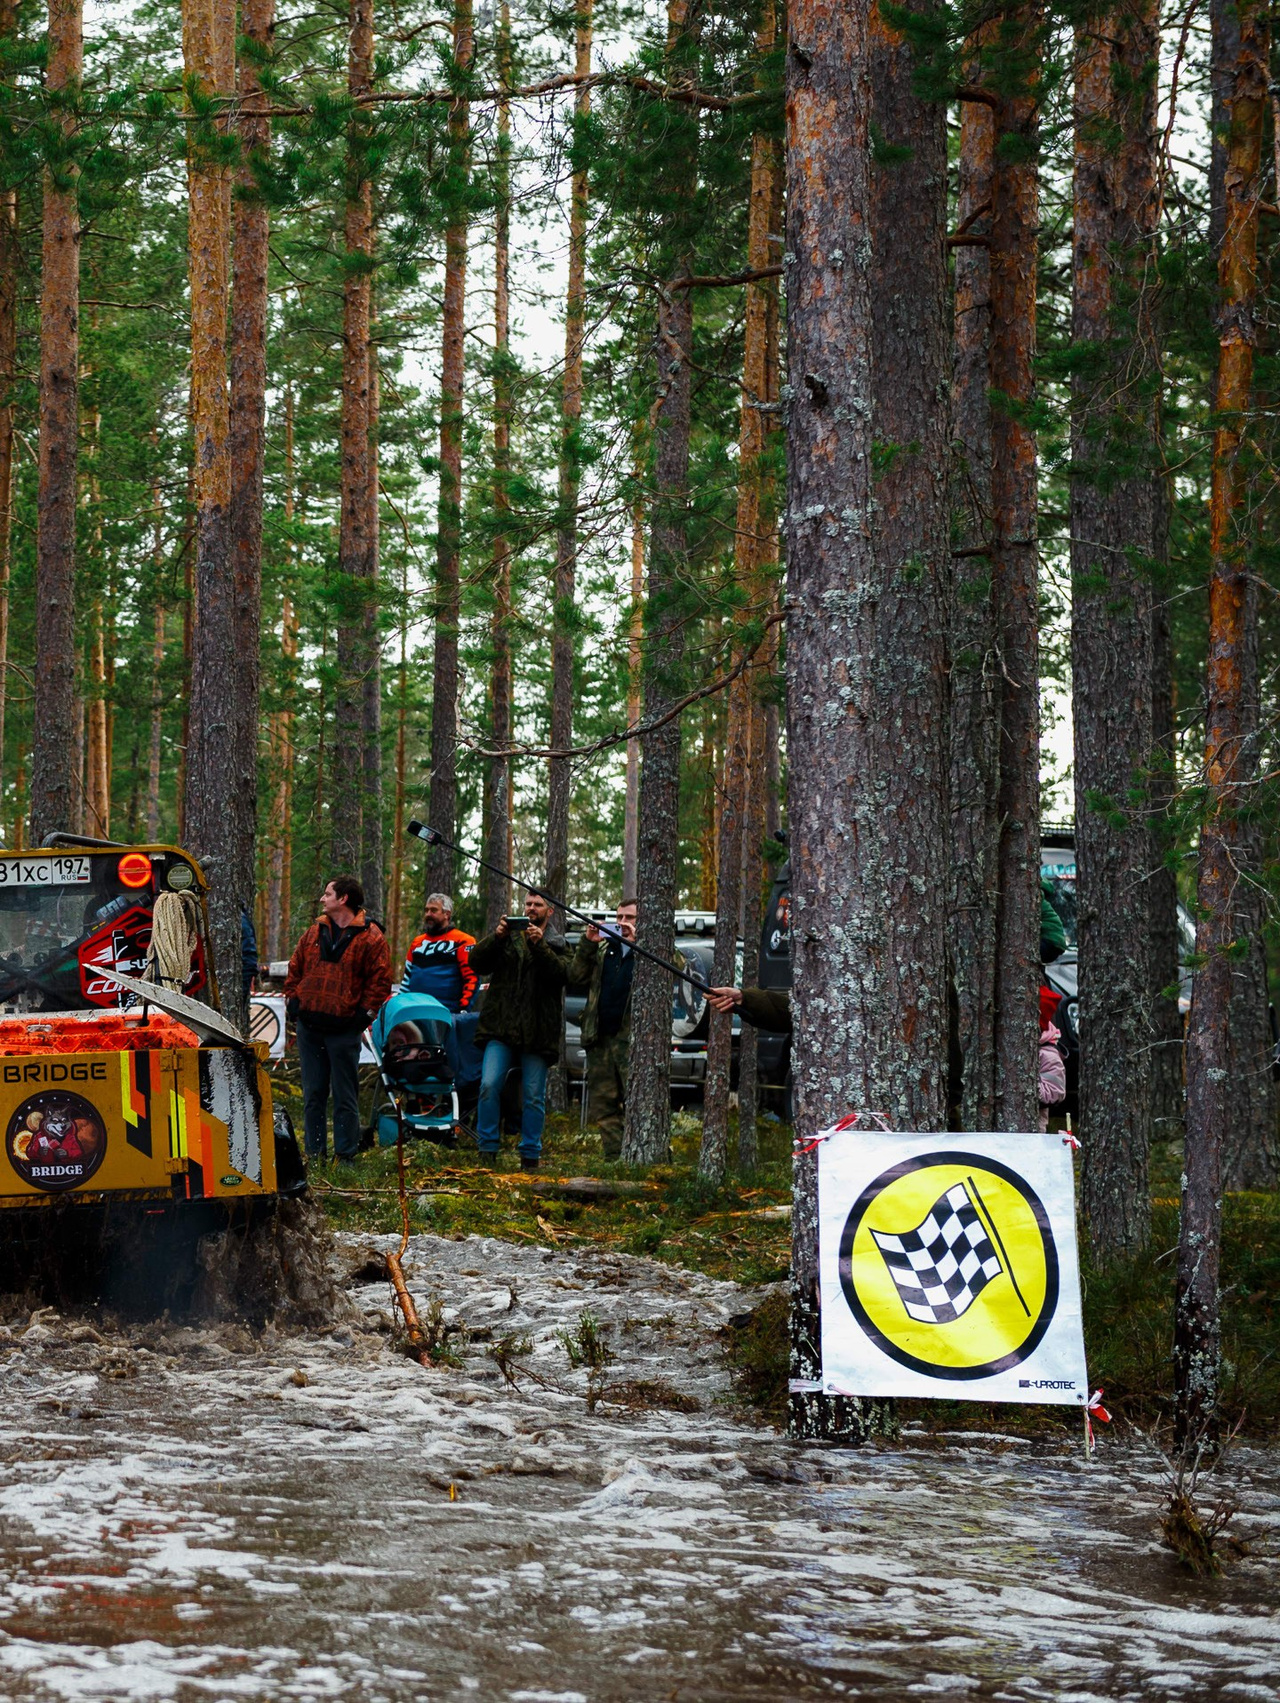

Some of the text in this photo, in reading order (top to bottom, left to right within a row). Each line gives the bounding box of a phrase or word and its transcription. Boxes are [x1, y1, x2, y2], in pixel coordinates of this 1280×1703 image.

[54, 858, 84, 875] 197
[3, 1062, 107, 1084] BRIDGE
[31, 1164, 83, 1177] BRIDGE
[1028, 1379, 1076, 1390] SUPROTEC
